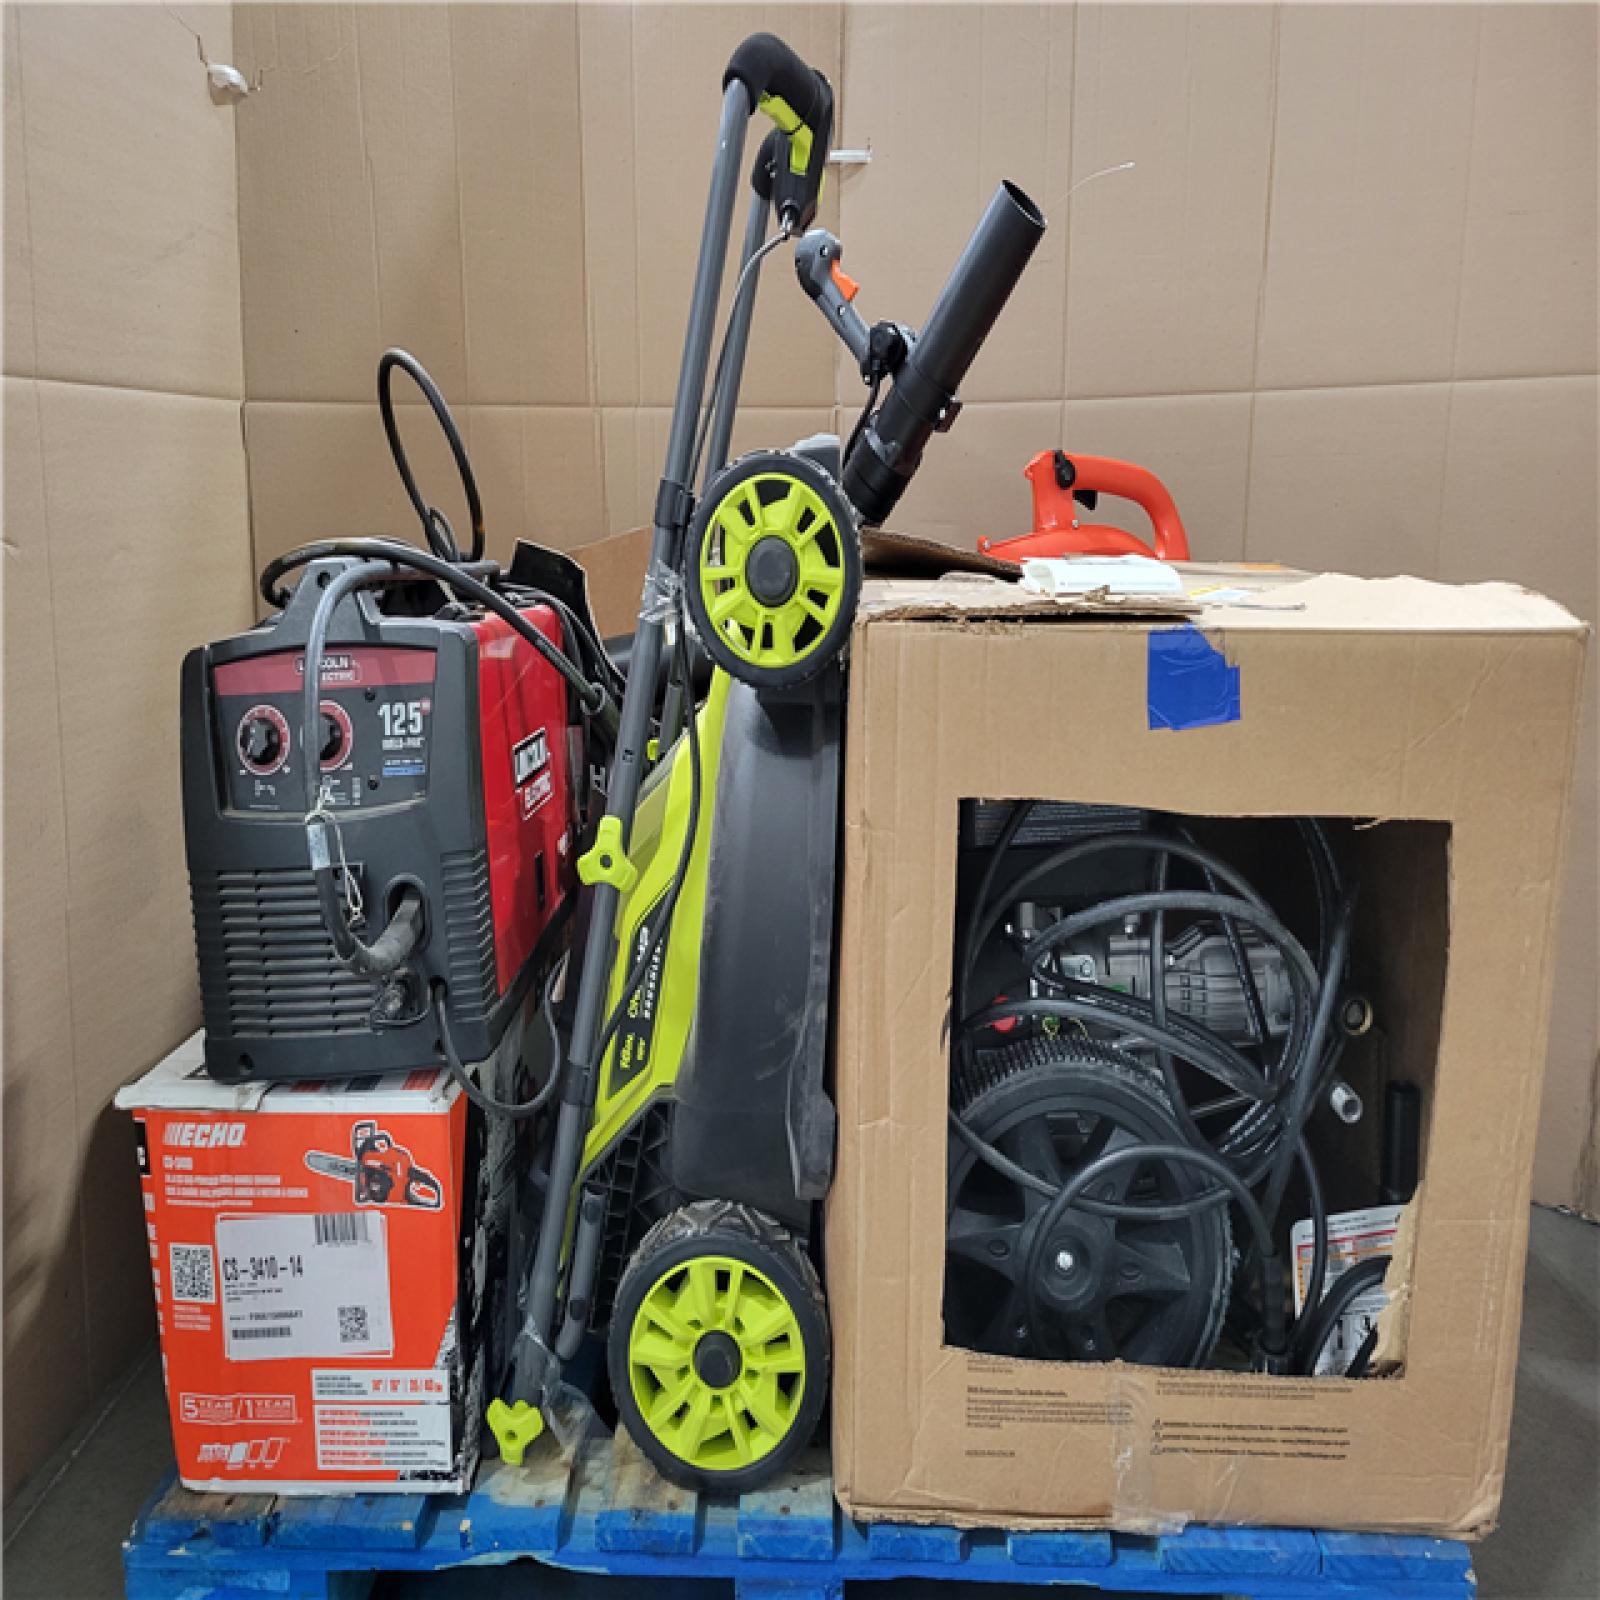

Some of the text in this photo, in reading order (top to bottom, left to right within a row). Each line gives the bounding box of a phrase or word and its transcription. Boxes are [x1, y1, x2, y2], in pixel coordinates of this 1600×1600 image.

[377, 702, 422, 736] 125
[179, 1121, 246, 1148] ECHO
[184, 1398, 198, 1418] 5
